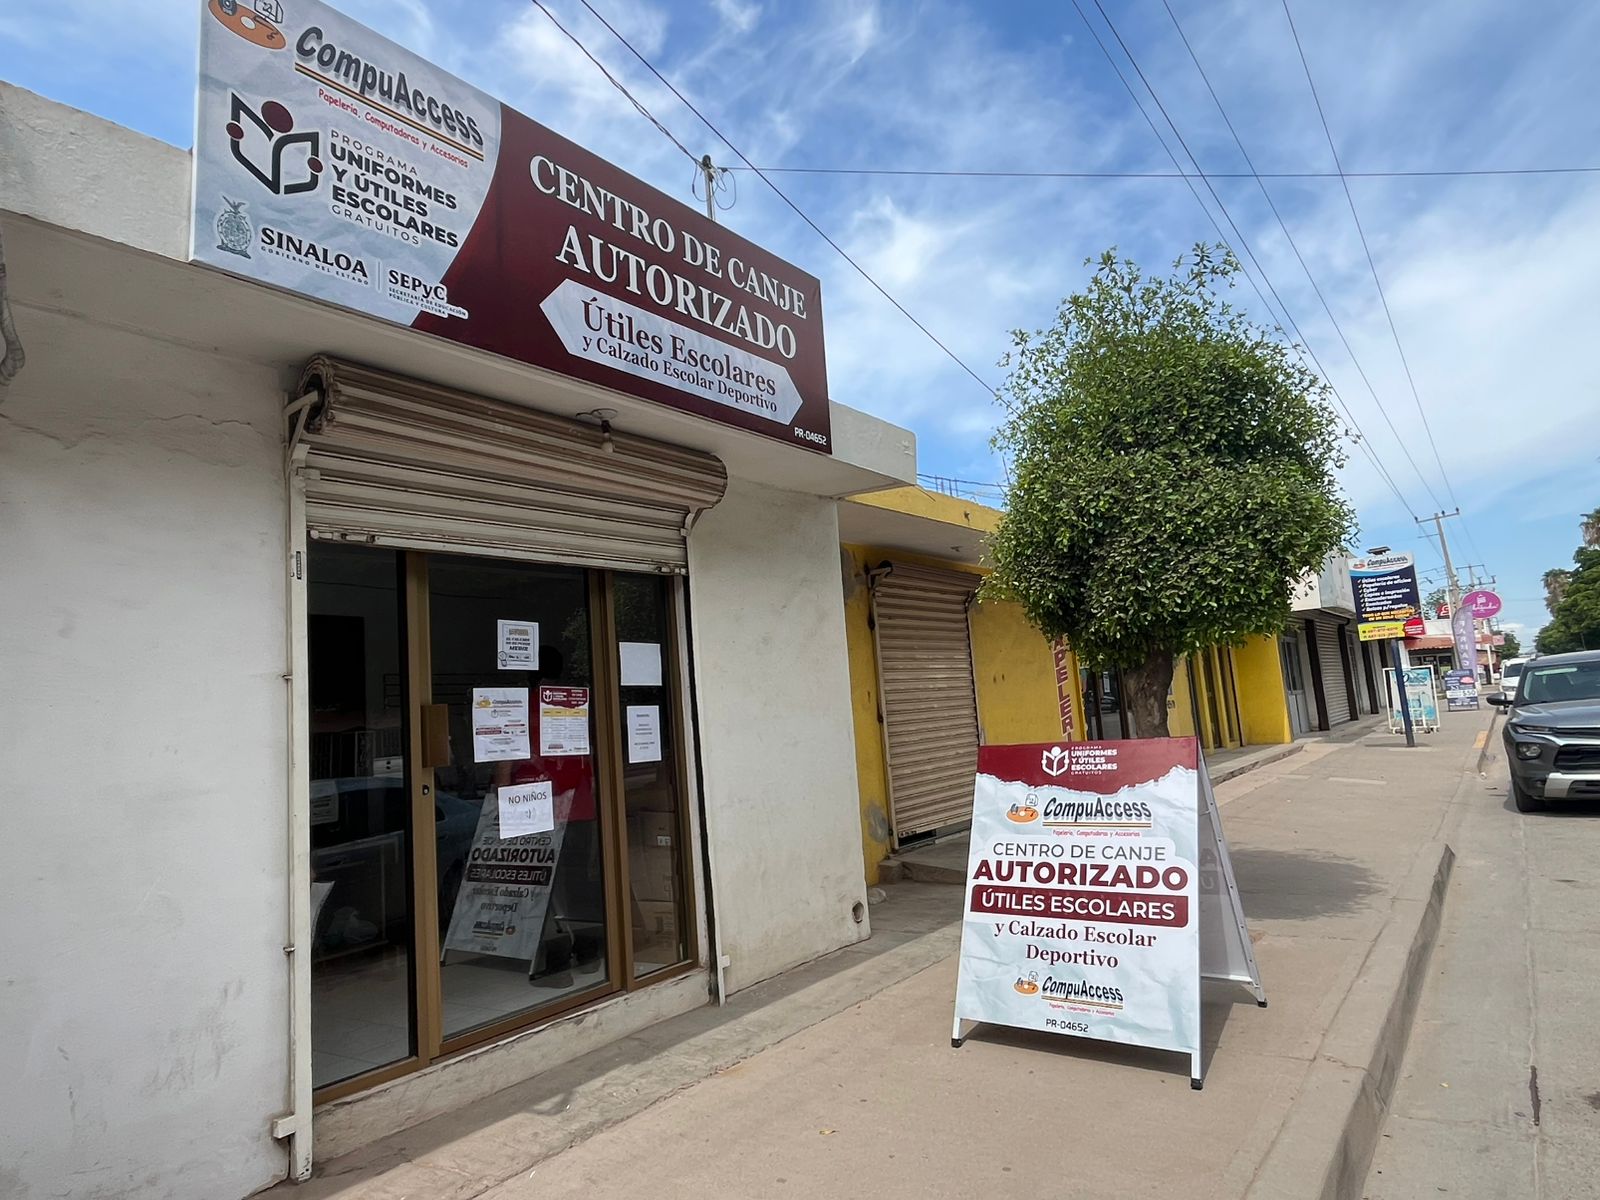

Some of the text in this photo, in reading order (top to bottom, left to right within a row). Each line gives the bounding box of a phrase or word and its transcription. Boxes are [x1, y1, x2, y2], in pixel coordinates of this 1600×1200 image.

[295, 26, 484, 147] CompuAccess
[331, 129, 418, 176] PROGRAMA
[364, 112, 420, 145] Computadoras
[422, 141, 428, 151] y
[430, 144, 469, 169] Accesorios
[330, 142, 457, 210] UNIFORMES
[331, 164, 428, 217] Y ÚTILES
[331, 204, 419, 245] GRATUITOS
[332, 184, 459, 248] ESCOLARES
[260, 227, 369, 279] SINALOA
[529, 154, 808, 320] CENTRO DE CANJE
[260, 245, 369, 286] GOBIERNO DEL ESTADO
[388, 269, 446, 301] SEPyC
[555, 224, 797, 360] AUTORIZADO
[580, 296, 777, 397] Útiles Escolares
[582, 335, 778, 413] y Calzado Escolar Deportivo
[793, 426, 828, 446] PR-04652
[1071, 749, 1118, 757] UNIFORMES
[1071, 763, 1118, 771] ESCOLARES
[1078, 755, 1105, 764] ÚTILES
[508, 791, 547, 805] NO NIÑOS
[1042, 797, 1152, 823] CompuAccess
[993, 842, 1166, 861] CENTRO DE CANJE
[972, 859, 1189, 891] AUTORIZADO
[982, 889, 1176, 921] ÚTILES ESCOLARES
[994, 920, 1157, 948] y Calzado Escolar
[1025, 944, 1119, 969] Deportivo
[1042, 975, 1124, 1002] CompuAccess
[1045, 1018, 1089, 1033] PR-04652
